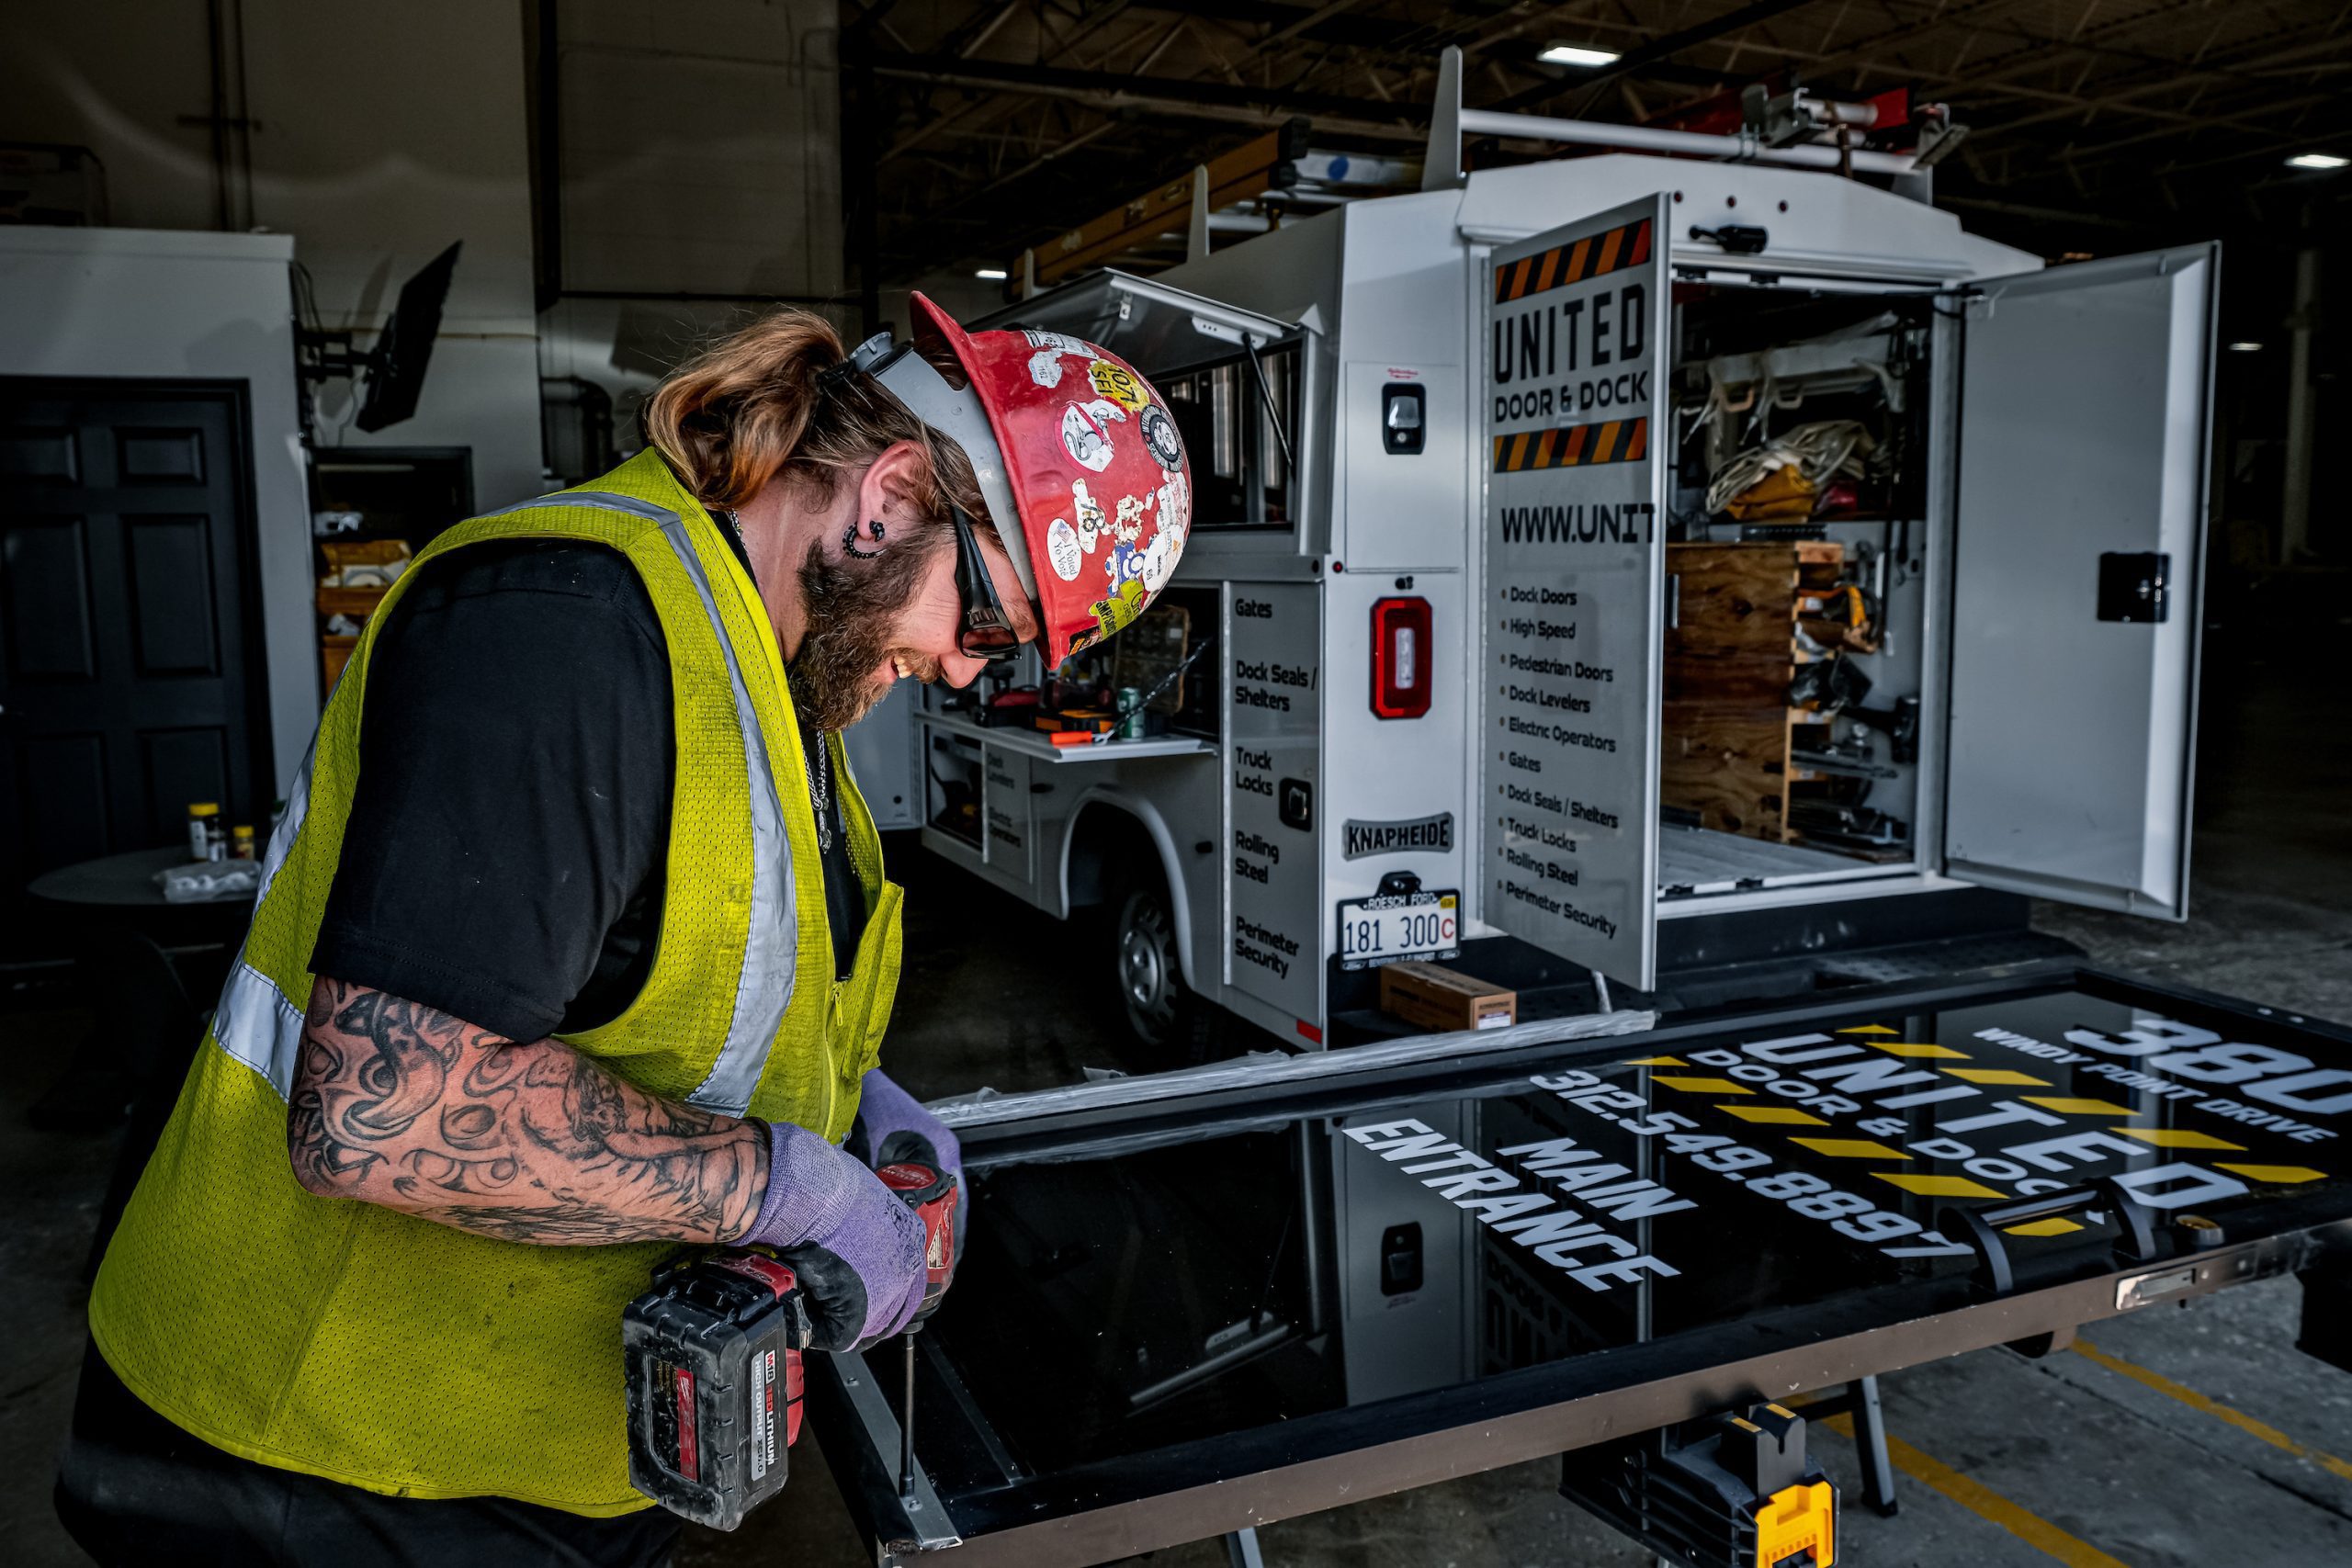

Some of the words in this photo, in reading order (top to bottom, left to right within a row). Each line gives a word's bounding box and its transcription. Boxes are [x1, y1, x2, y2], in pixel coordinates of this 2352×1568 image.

[1495, 284, 1645, 384] UNITED
[1496, 389, 1553, 423] DOOR
[1561, 385, 1572, 412] &
[1579, 371, 1647, 411] DOCK
[1501, 503, 1656, 544] WWW.UNIT
[1235, 598, 1272, 618] Gates
[1510, 586, 1539, 604] Dock
[1541, 588, 1577, 605] Doors
[1510, 618, 1536, 638] High
[1538, 621, 1577, 641] Speed
[1236, 660, 1268, 682] Dock
[1272, 664, 1308, 688] Seals
[1510, 653, 1572, 677] Pedestrian
[1575, 661, 1613, 682] Doors
[1235, 686, 1290, 713] Shelters
[1510, 685, 1537, 704] Dock
[1540, 690, 1590, 714] Levelers
[1510, 716, 1550, 739] Electric
[1553, 725, 1616, 753] Operators
[1236, 746, 1272, 772] Truck
[1509, 751, 1542, 773] Gates
[1236, 771, 1273, 797] Locks
[1508, 784, 1532, 803] Dock
[1534, 791, 1563, 814] Seals
[1571, 801, 1619, 829] Shelters
[1235, 830, 1279, 864] Rolling
[1348, 819, 1450, 854] KNAPHEIDE
[1508, 817, 1540, 841] Truck
[1543, 828, 1577, 852] Locks
[1235, 857, 1269, 885] Steel
[1507, 849, 1544, 878] Rolling
[1547, 862, 1578, 886] Steel
[1368, 895, 1407, 910] ROESCH
[1507, 881, 1562, 915] Perimeter
[1564, 902, 1617, 940] Security
[1236, 916, 1299, 957] Perimeter
[1344, 919, 1383, 954] 181
[1235, 938, 1288, 980] Security
[2064, 1019, 2352, 1114] 380
[1687, 1049, 1861, 1116] DOOR
[1857, 1117, 1909, 1136] &
[1973, 1027, 2096, 1065] WINDY
[2082, 1064, 2209, 1100] POINT
[2193, 1099, 2339, 1144] DRIVE
[1741, 1033, 2250, 1209] UNITED
[1496, 1137, 1699, 1221] MAIN
[1530, 1069, 1975, 1258] 312.549.8897
[1341, 1118, 1682, 1292] ENTRANCE
[755, 1393, 763, 1436] OUTPUT
